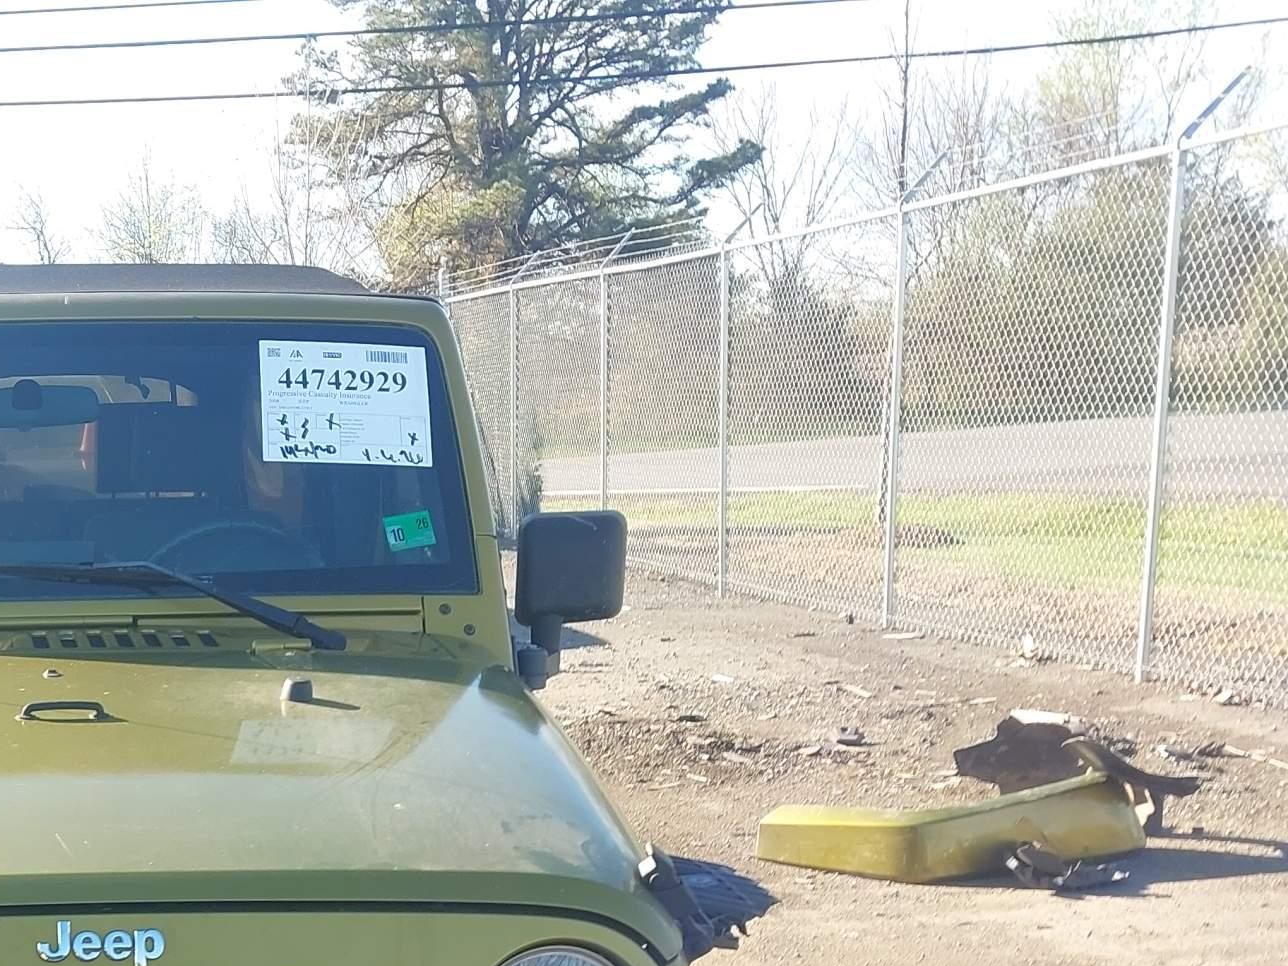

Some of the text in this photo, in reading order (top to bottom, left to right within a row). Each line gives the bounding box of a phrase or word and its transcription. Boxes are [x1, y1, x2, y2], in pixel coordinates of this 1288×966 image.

[278, 367, 407, 393] 44742929
[268, 390, 307, 399] Progressive
[416, 518, 429, 529] 26
[391, 527, 405, 542] 10
